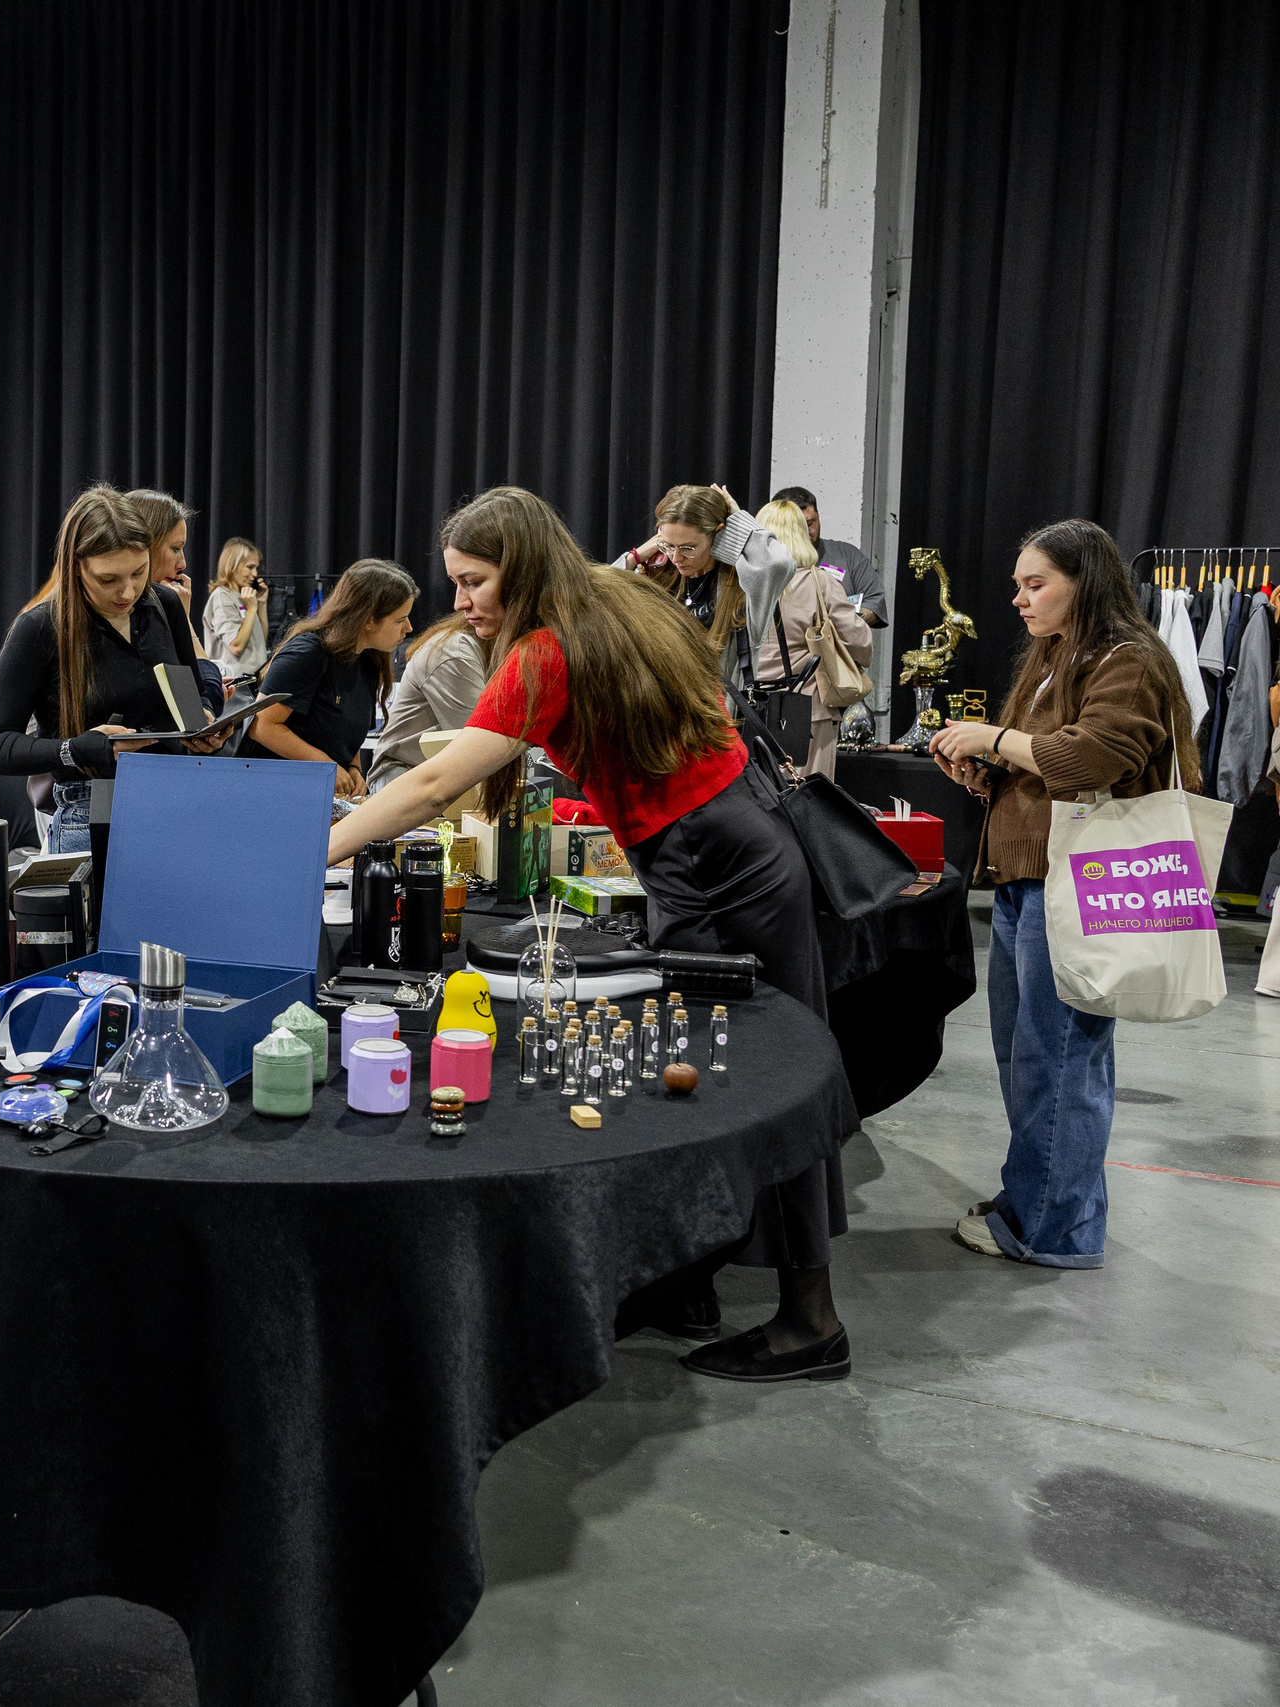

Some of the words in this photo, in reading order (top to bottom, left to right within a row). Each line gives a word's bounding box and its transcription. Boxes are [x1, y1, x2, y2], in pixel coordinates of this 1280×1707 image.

[1110, 853, 1189, 879] БОЖЕ,
[1086, 892, 1146, 911] ЧТО
[1152, 889, 1172, 910] Я
[1088, 919, 1141, 931] НИЧЕГО
[1144, 916, 1194, 929] ЛИШНЕГО
[614, 1060, 622, 1068] 12
